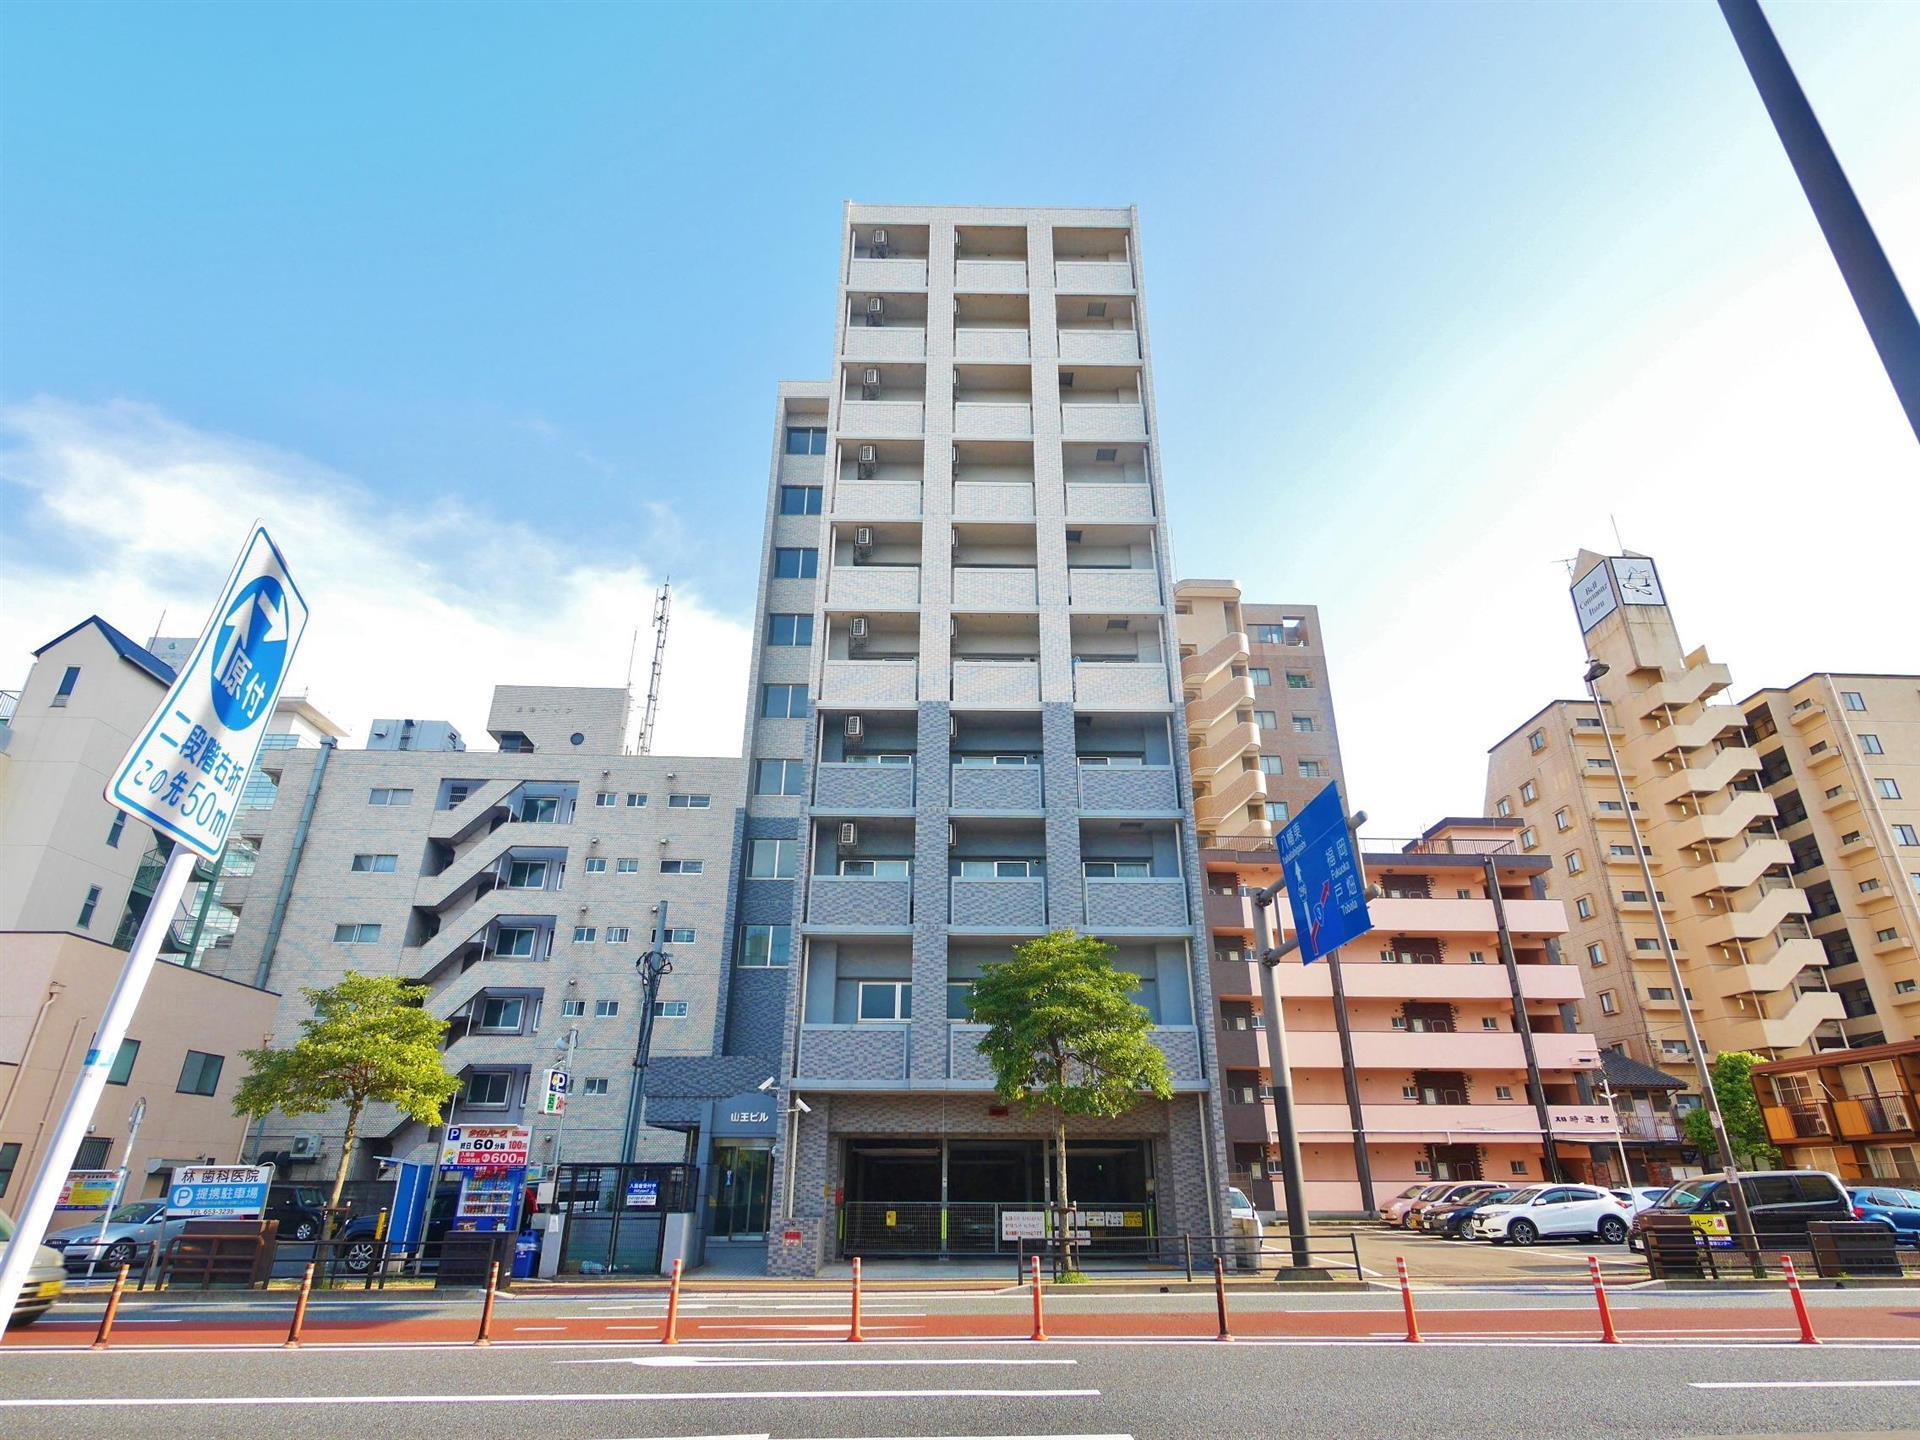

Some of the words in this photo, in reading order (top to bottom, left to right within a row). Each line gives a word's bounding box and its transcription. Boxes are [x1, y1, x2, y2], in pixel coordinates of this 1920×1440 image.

[221, 647, 266, 719] 原付
[160, 710, 244, 796] 二段階右折
[134, 759, 227, 838] この先50m
[730, 1111, 769, 1122] 山王ビル
[449, 1128, 460, 1140] P
[181, 1170, 196, 1183] 林
[201, 1169, 260, 1183] 歯科医院
[177, 1189, 190, 1204] P
